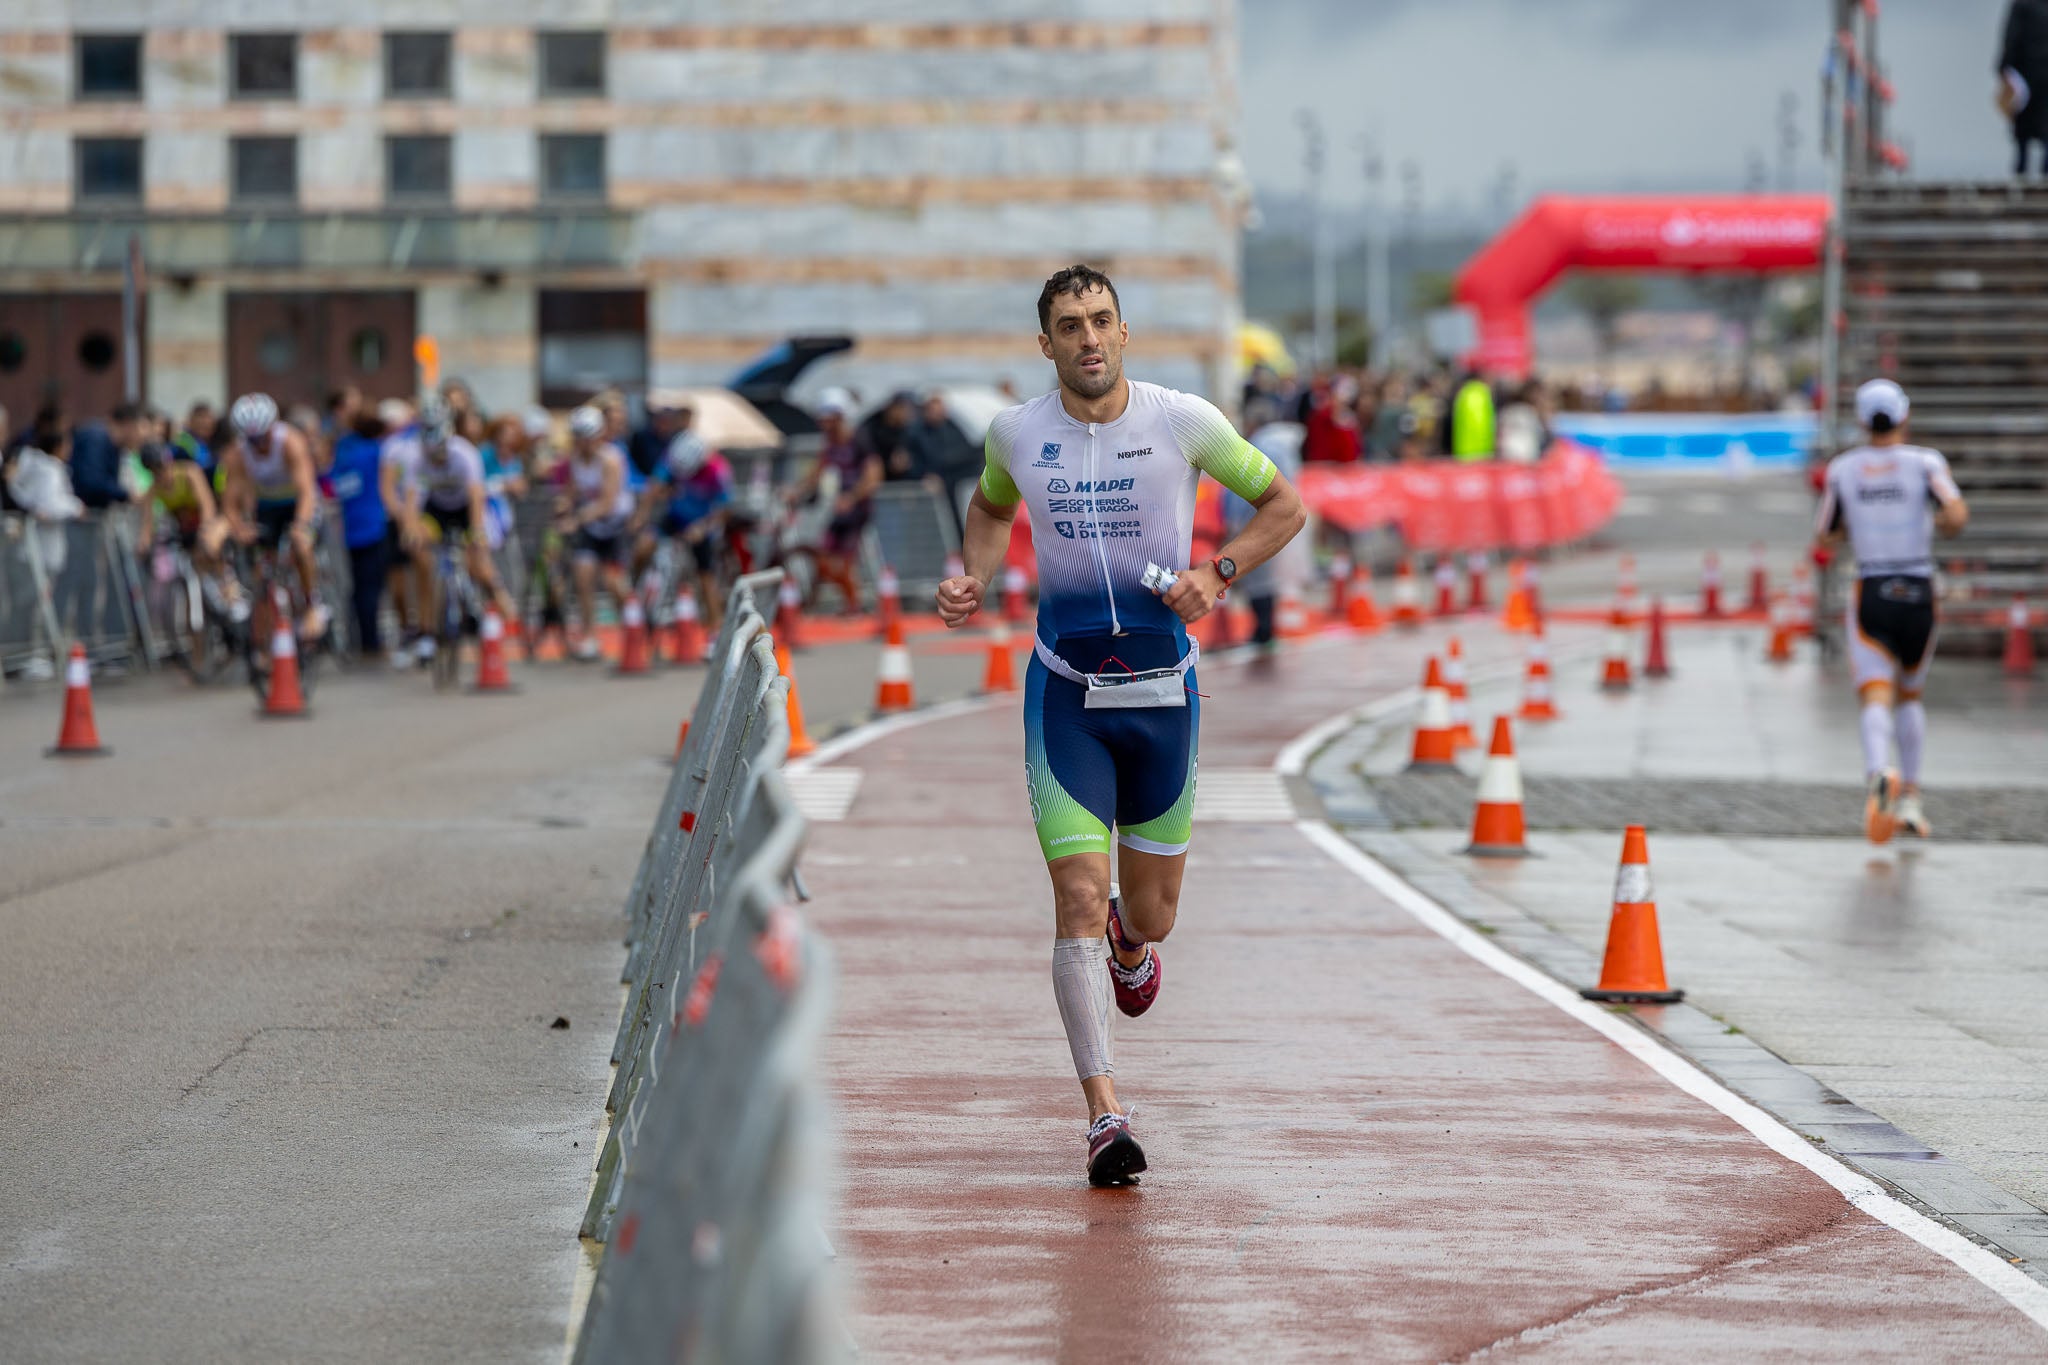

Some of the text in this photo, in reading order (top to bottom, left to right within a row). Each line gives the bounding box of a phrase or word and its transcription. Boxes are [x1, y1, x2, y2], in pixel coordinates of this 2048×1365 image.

[1074, 477, 1135, 493] MAPEI
[1068, 497, 1130, 506] GOBIERNO
[1079, 530, 1142, 538] DEPORTE
[1049, 833, 1105, 846] HAMMELMANN
